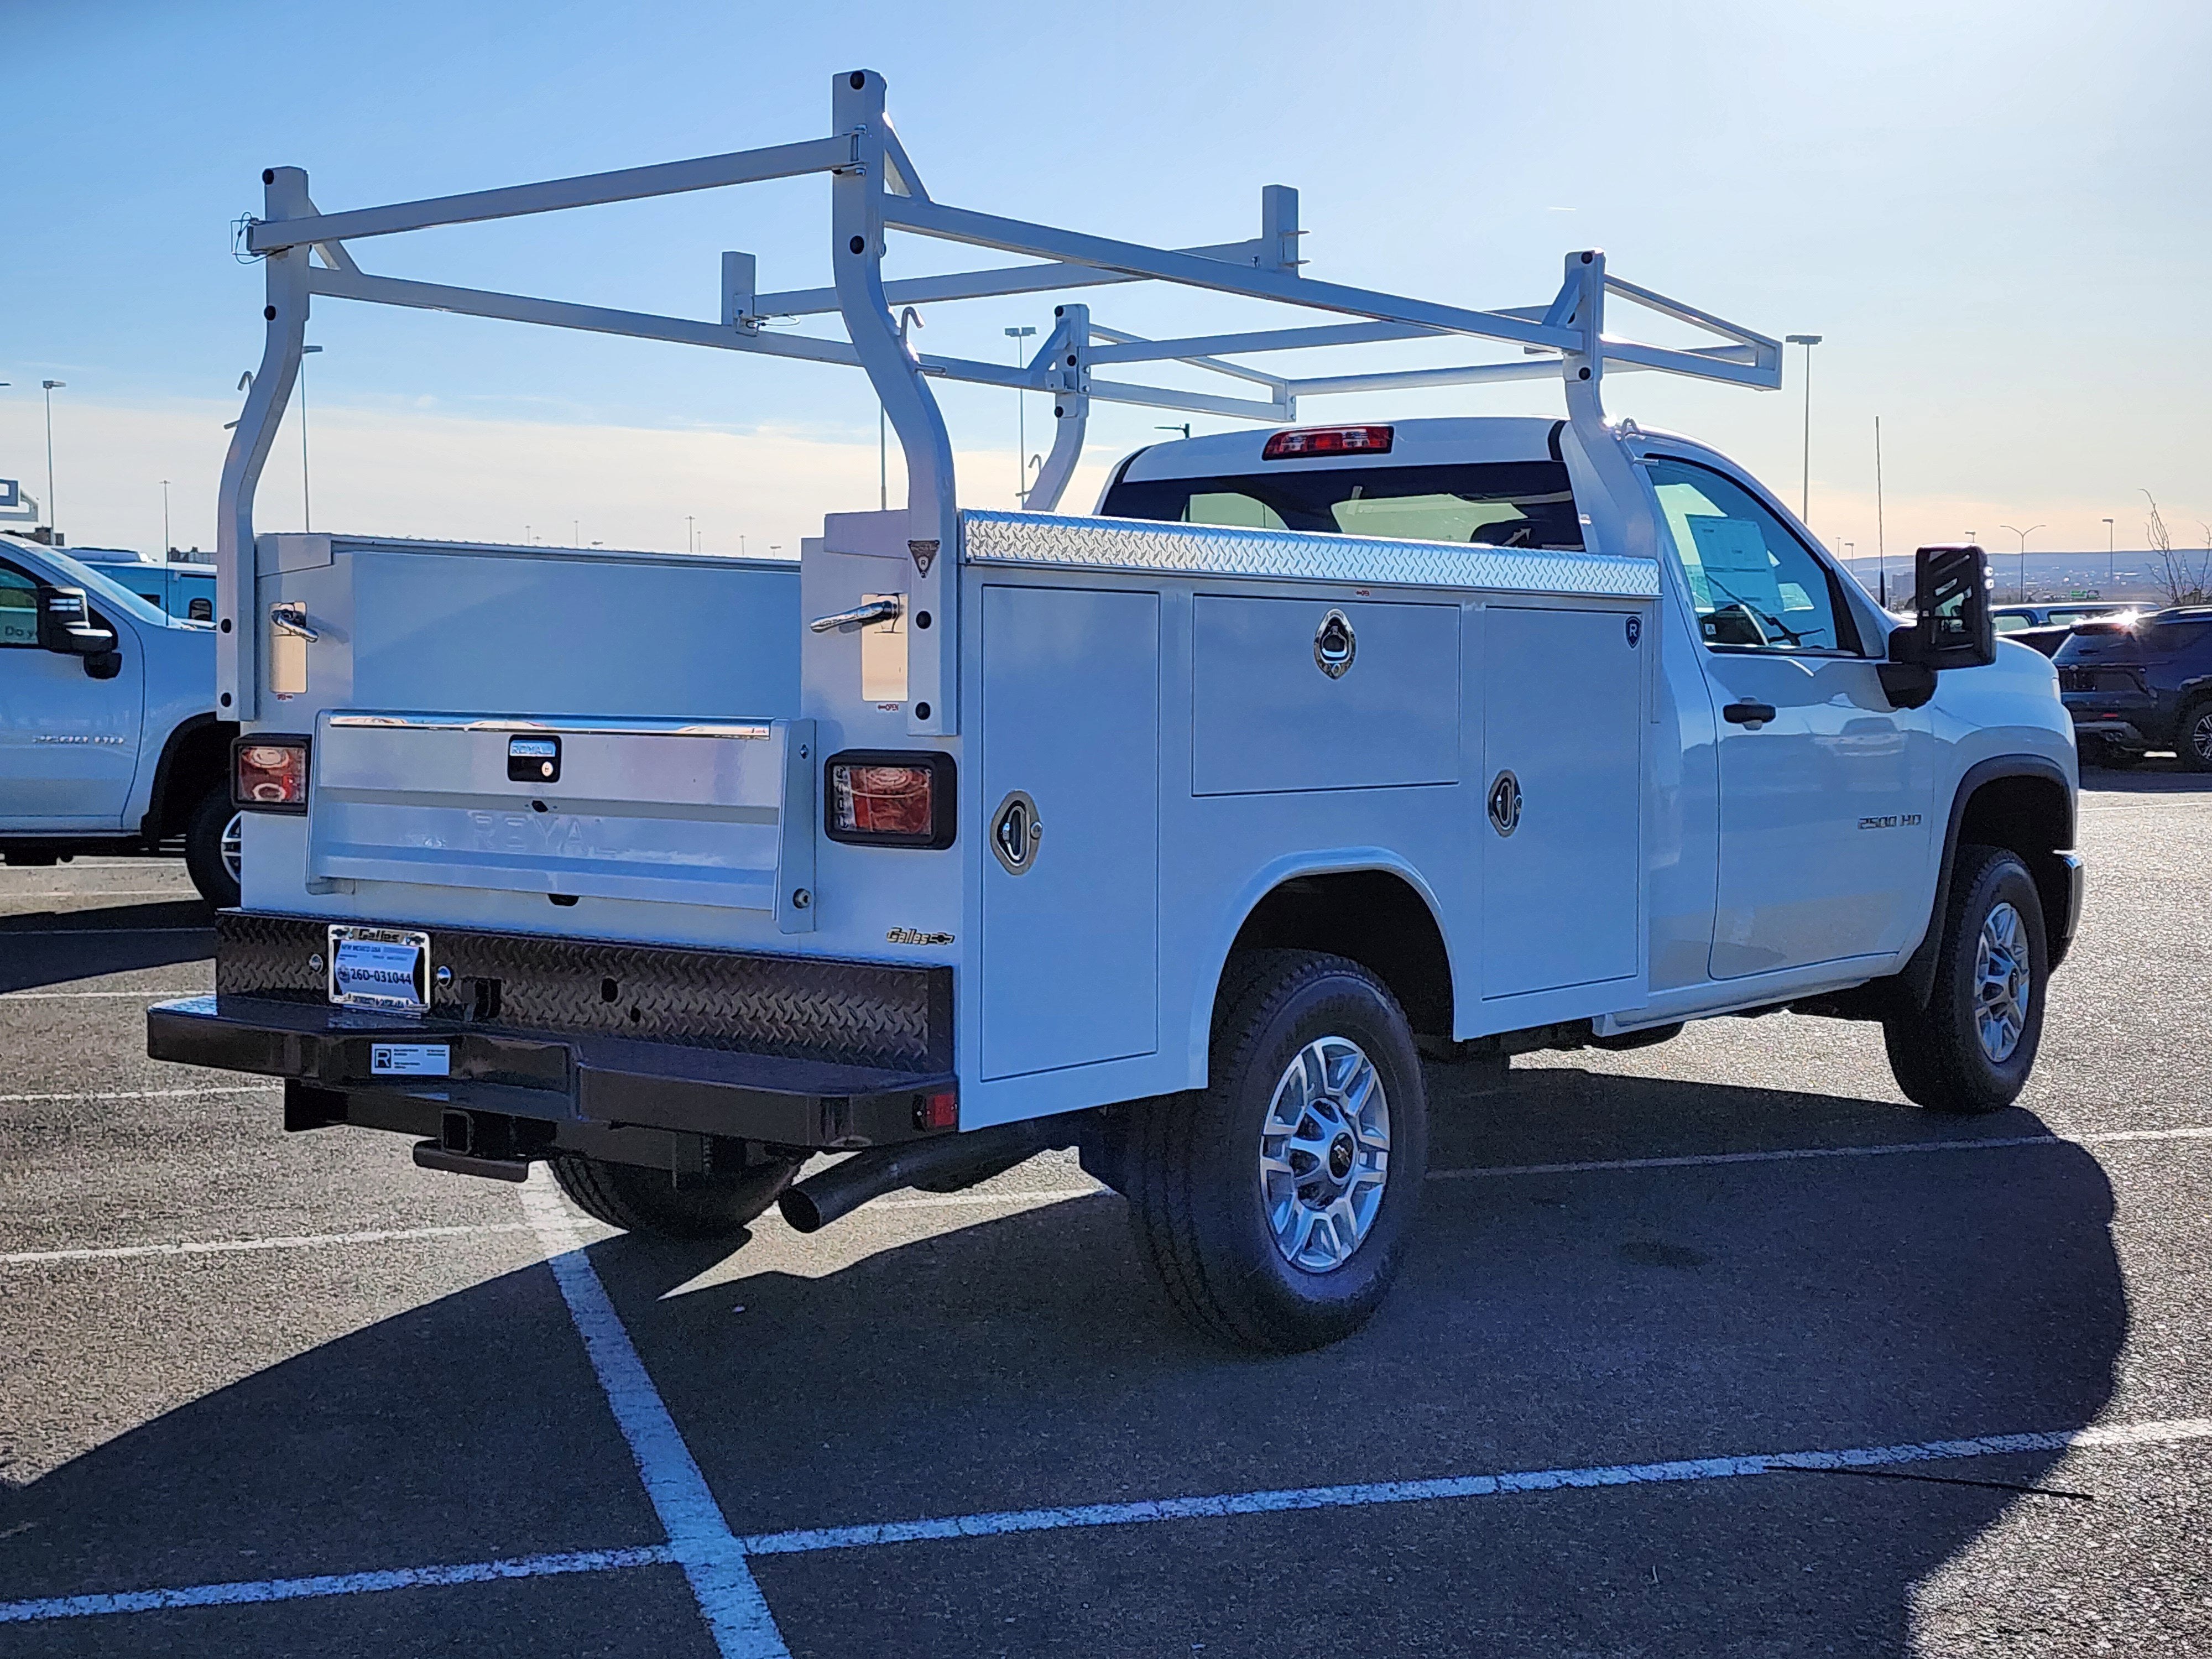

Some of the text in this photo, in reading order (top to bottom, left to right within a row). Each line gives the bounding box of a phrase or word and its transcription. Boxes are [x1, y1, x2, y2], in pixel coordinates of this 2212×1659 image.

[1629, 623, 1637, 637] R
[1858, 814, 1922, 830] 2500 HD
[886, 927, 930, 944] Galles
[350, 968, 411, 985] 26D-031044
[375, 1050, 390, 1067] R
